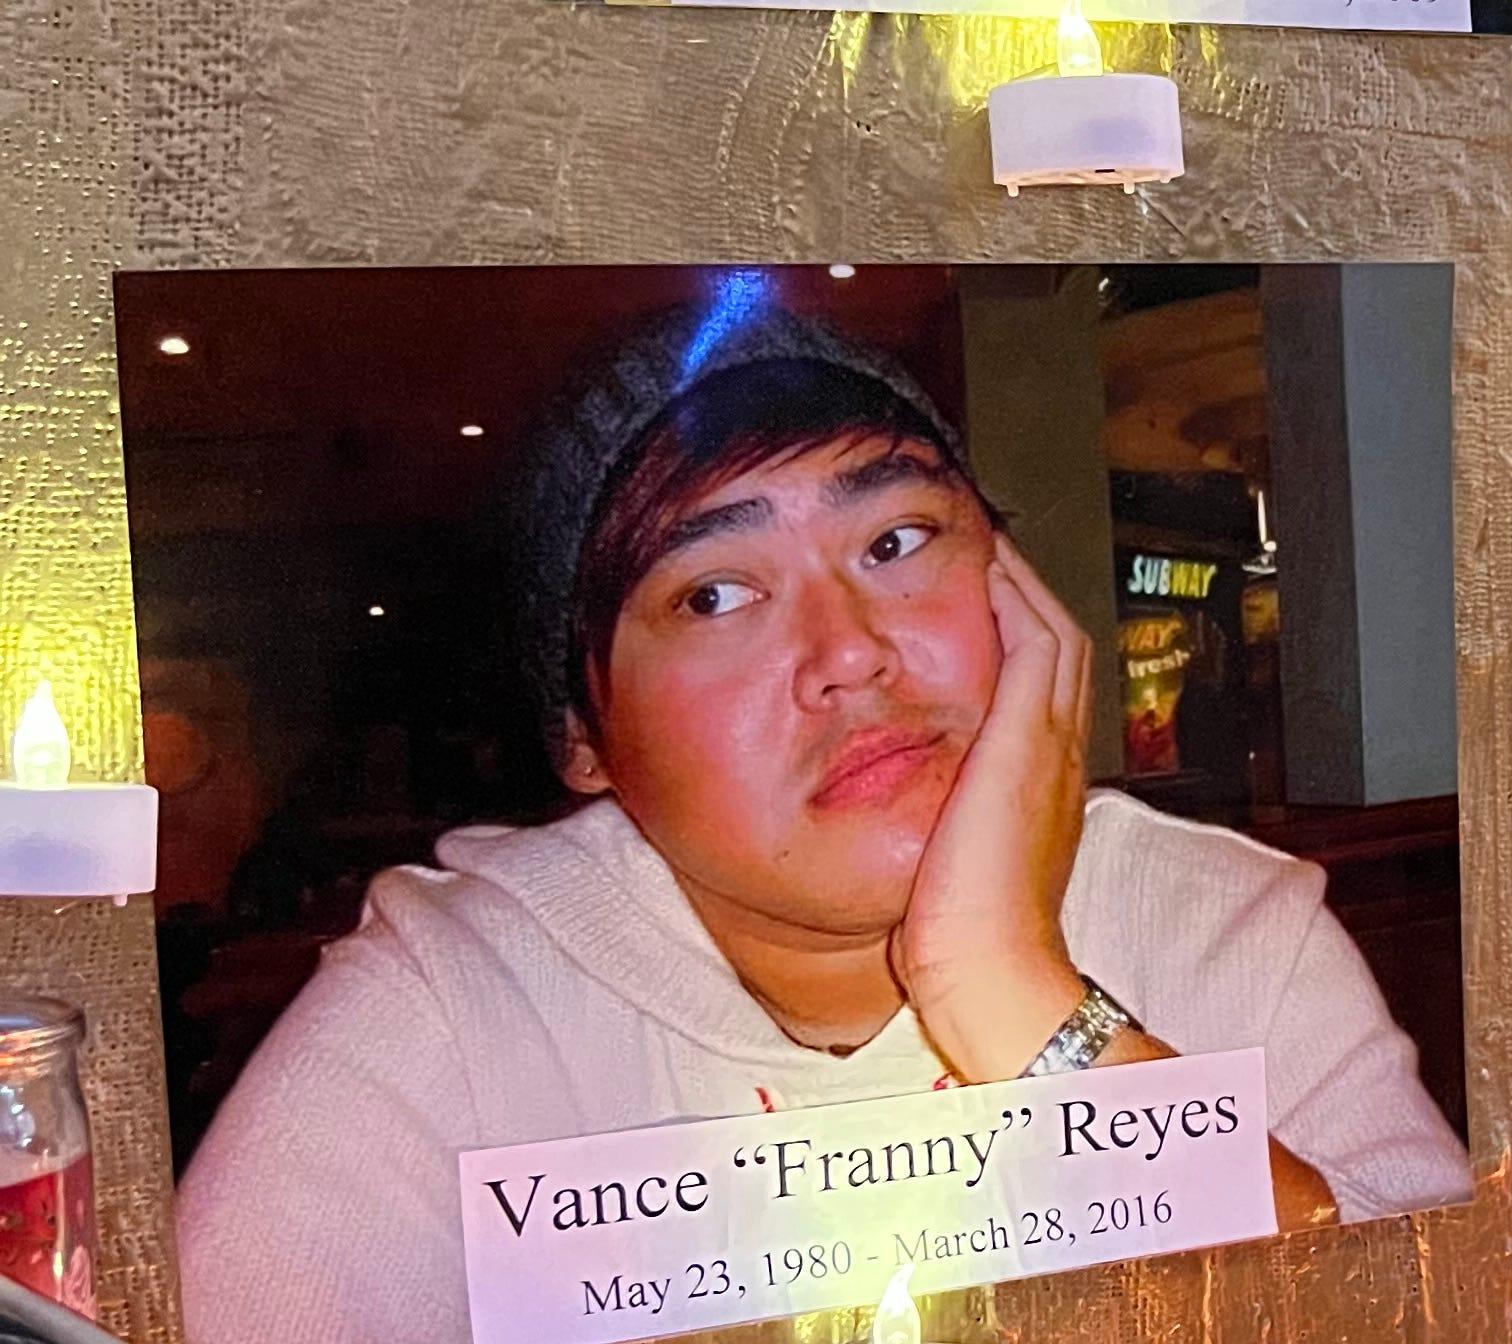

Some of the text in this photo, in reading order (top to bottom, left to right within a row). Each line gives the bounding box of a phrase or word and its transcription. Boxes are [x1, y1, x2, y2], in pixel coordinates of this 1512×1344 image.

[1128, 554, 1218, 598] SUBWAY
[483, 1091, 1240, 1240] Vance “Franny” Reyes
[581, 1267, 675, 1320] May
[686, 1260, 747, 1303] 23,
[764, 1241, 853, 1288] 1980
[893, 1216, 1011, 1270] March
[1021, 1207, 1077, 1249] 28,
[1088, 1189, 1174, 1238] 2016
